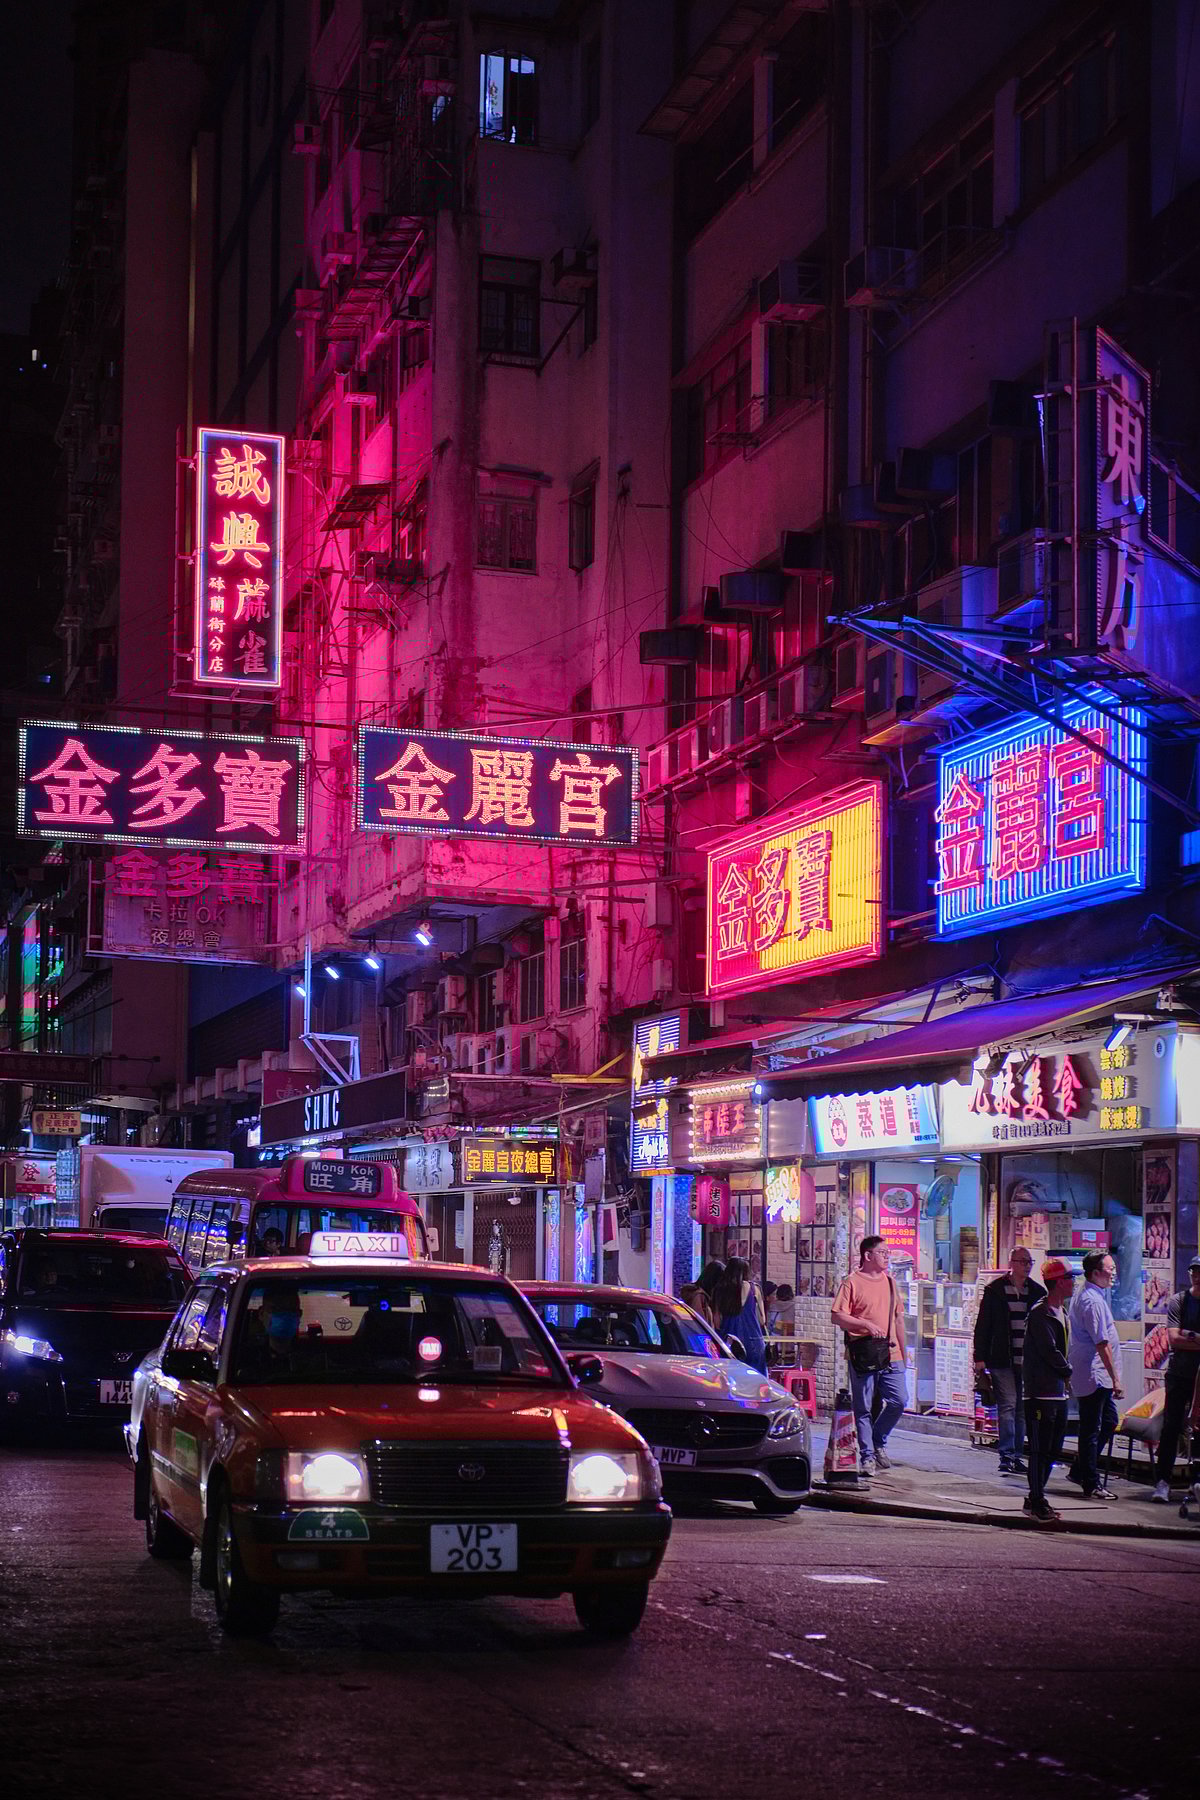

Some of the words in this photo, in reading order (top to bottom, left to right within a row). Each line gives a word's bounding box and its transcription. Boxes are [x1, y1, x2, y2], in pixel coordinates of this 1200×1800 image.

[29, 739, 292, 837] 金多寶
[375, 741, 622, 837] 金麗宮
[933, 726, 1106, 896] 金麗宮
[716, 828, 833, 961] 金多寶
[143, 903, 226, 925] 卡拉OK
[150, 928, 222, 948] 夜總會
[311, 1162, 344, 1174] Mong
[351, 1165, 374, 1176] Kok
[467, 1149, 553, 1174] 金麗宮夜總會
[309, 1173, 372, 1193] 旺角
[323, 1236, 399, 1252] TAXI
[421, 1343, 440, 1355] TAXI
[114, 1380, 131, 1392] WH
[661, 1448, 686, 1463] MVP
[320, 1513, 336, 1528] 4
[305, 1529, 353, 1538] SEATS
[457, 1525, 493, 1548] VP
[447, 1549, 503, 1571] 203
